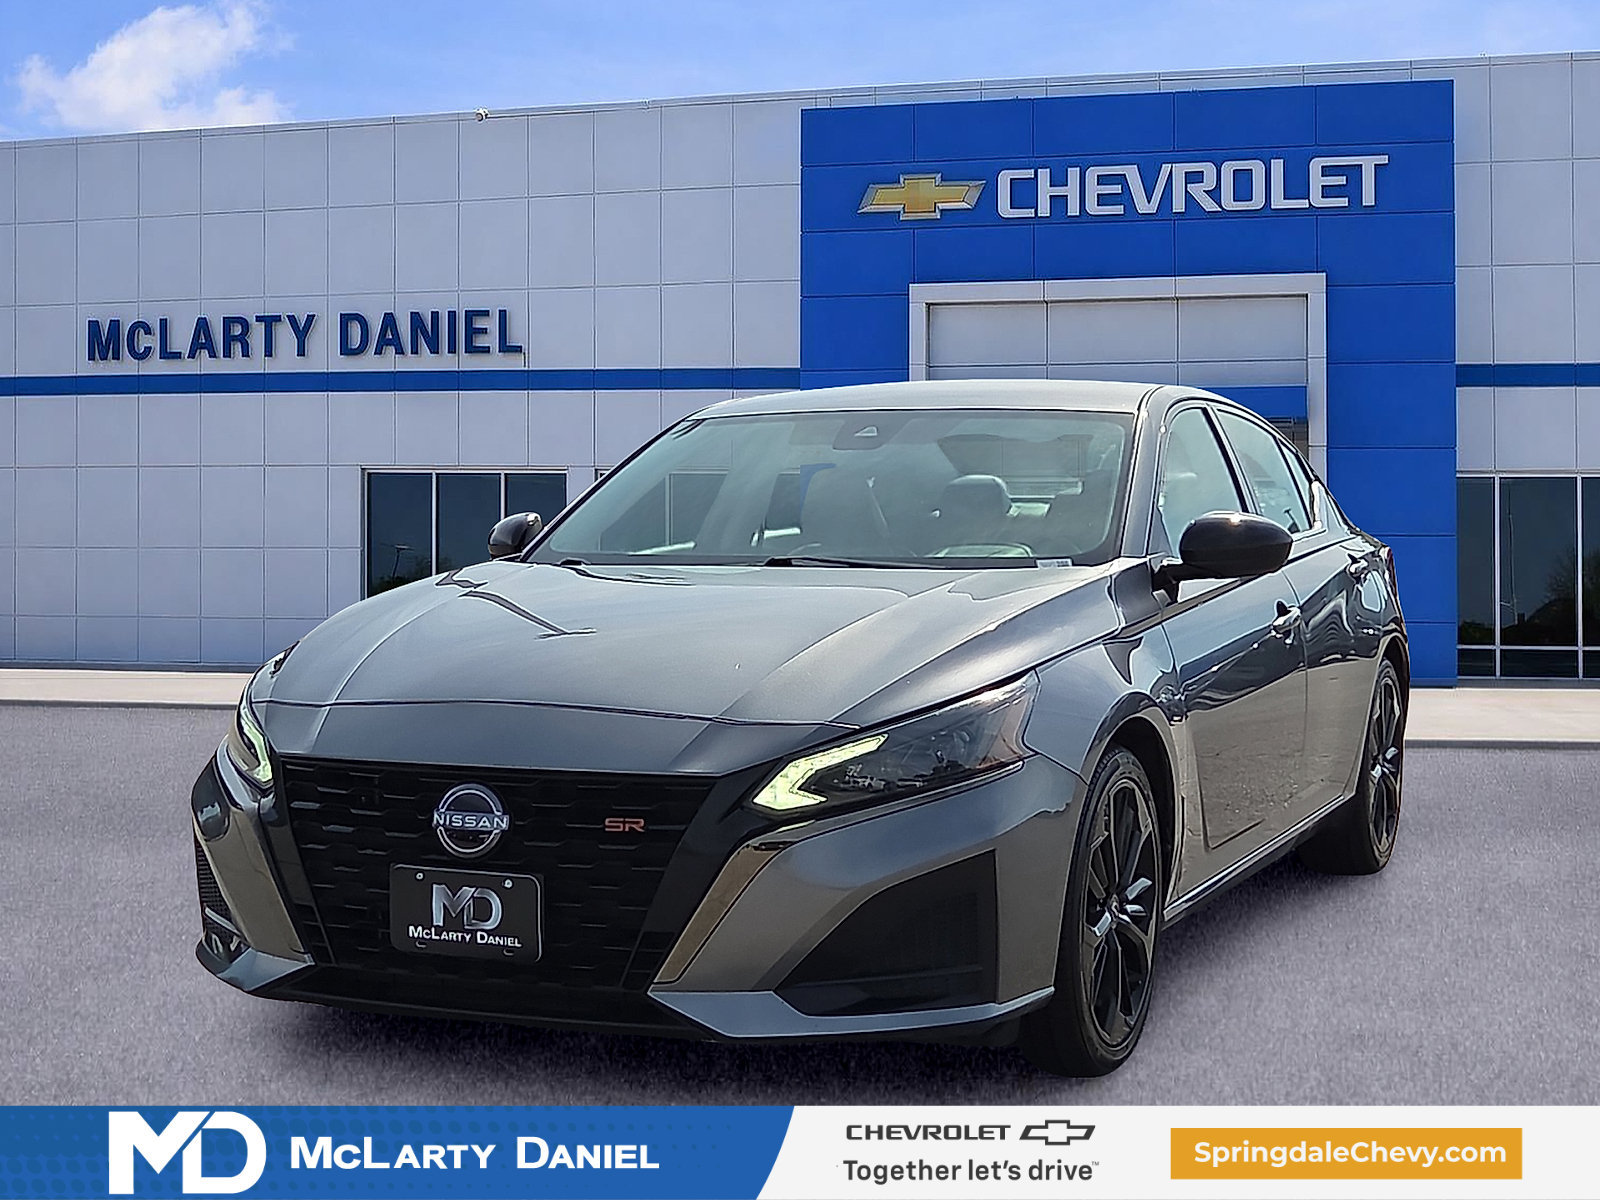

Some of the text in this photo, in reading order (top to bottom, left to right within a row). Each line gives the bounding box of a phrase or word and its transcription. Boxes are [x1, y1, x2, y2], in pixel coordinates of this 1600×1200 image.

[997, 154, 1389, 218] CHEVROLET
[339, 308, 524, 357] DANIEL
[433, 809, 509, 831] NISSAN
[604, 817, 645, 833] SR
[432, 883, 503, 930] MD
